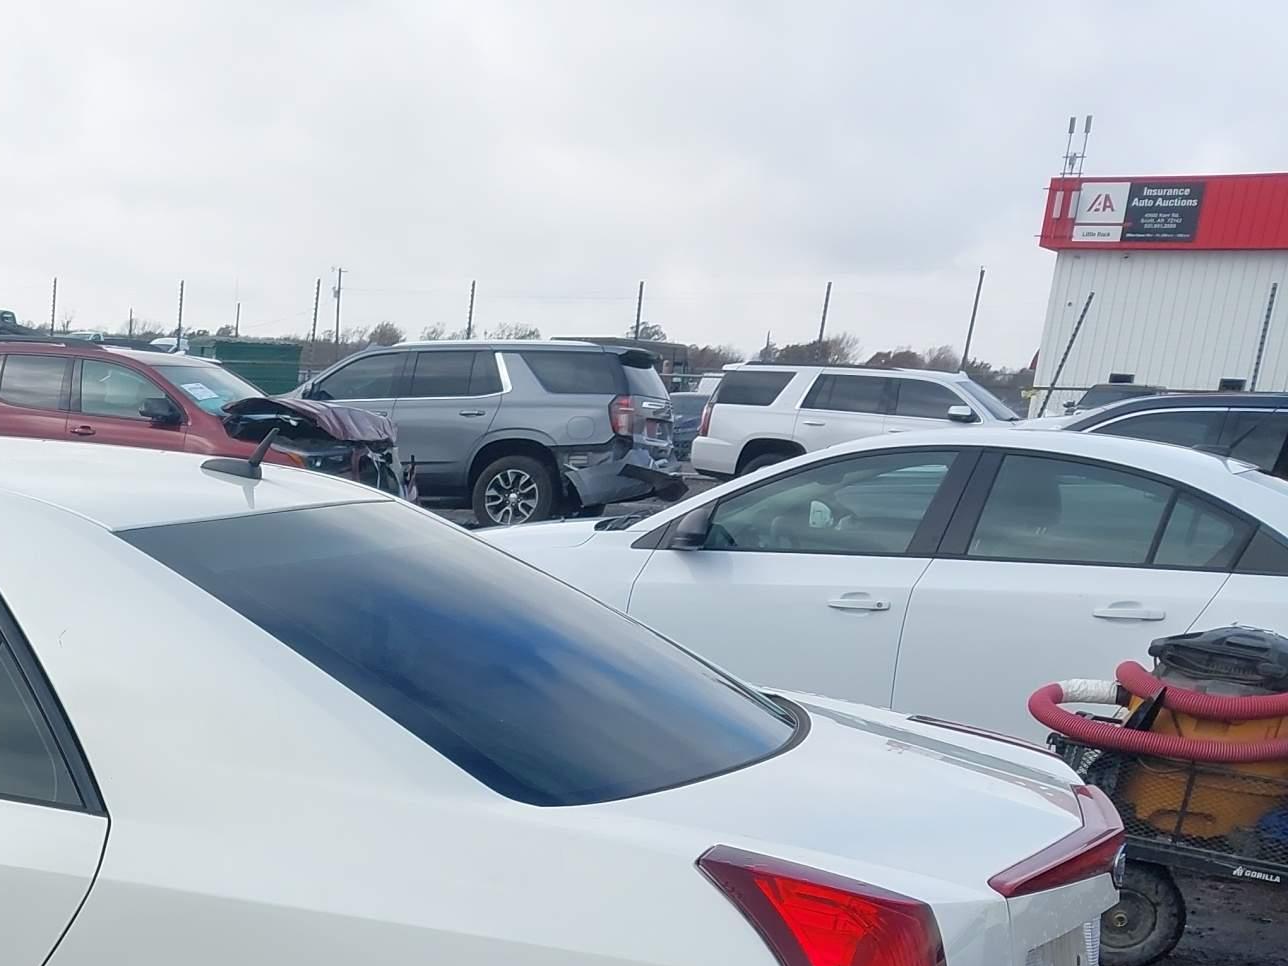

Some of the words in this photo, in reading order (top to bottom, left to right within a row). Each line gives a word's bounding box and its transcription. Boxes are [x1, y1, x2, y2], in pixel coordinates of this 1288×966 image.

[1143, 186, 1191, 196] Insurance
[1132, 197, 1154, 207] Auto
[1155, 196, 1199, 207] Auctions
[1244, 870, 1281, 883] GORILLA
